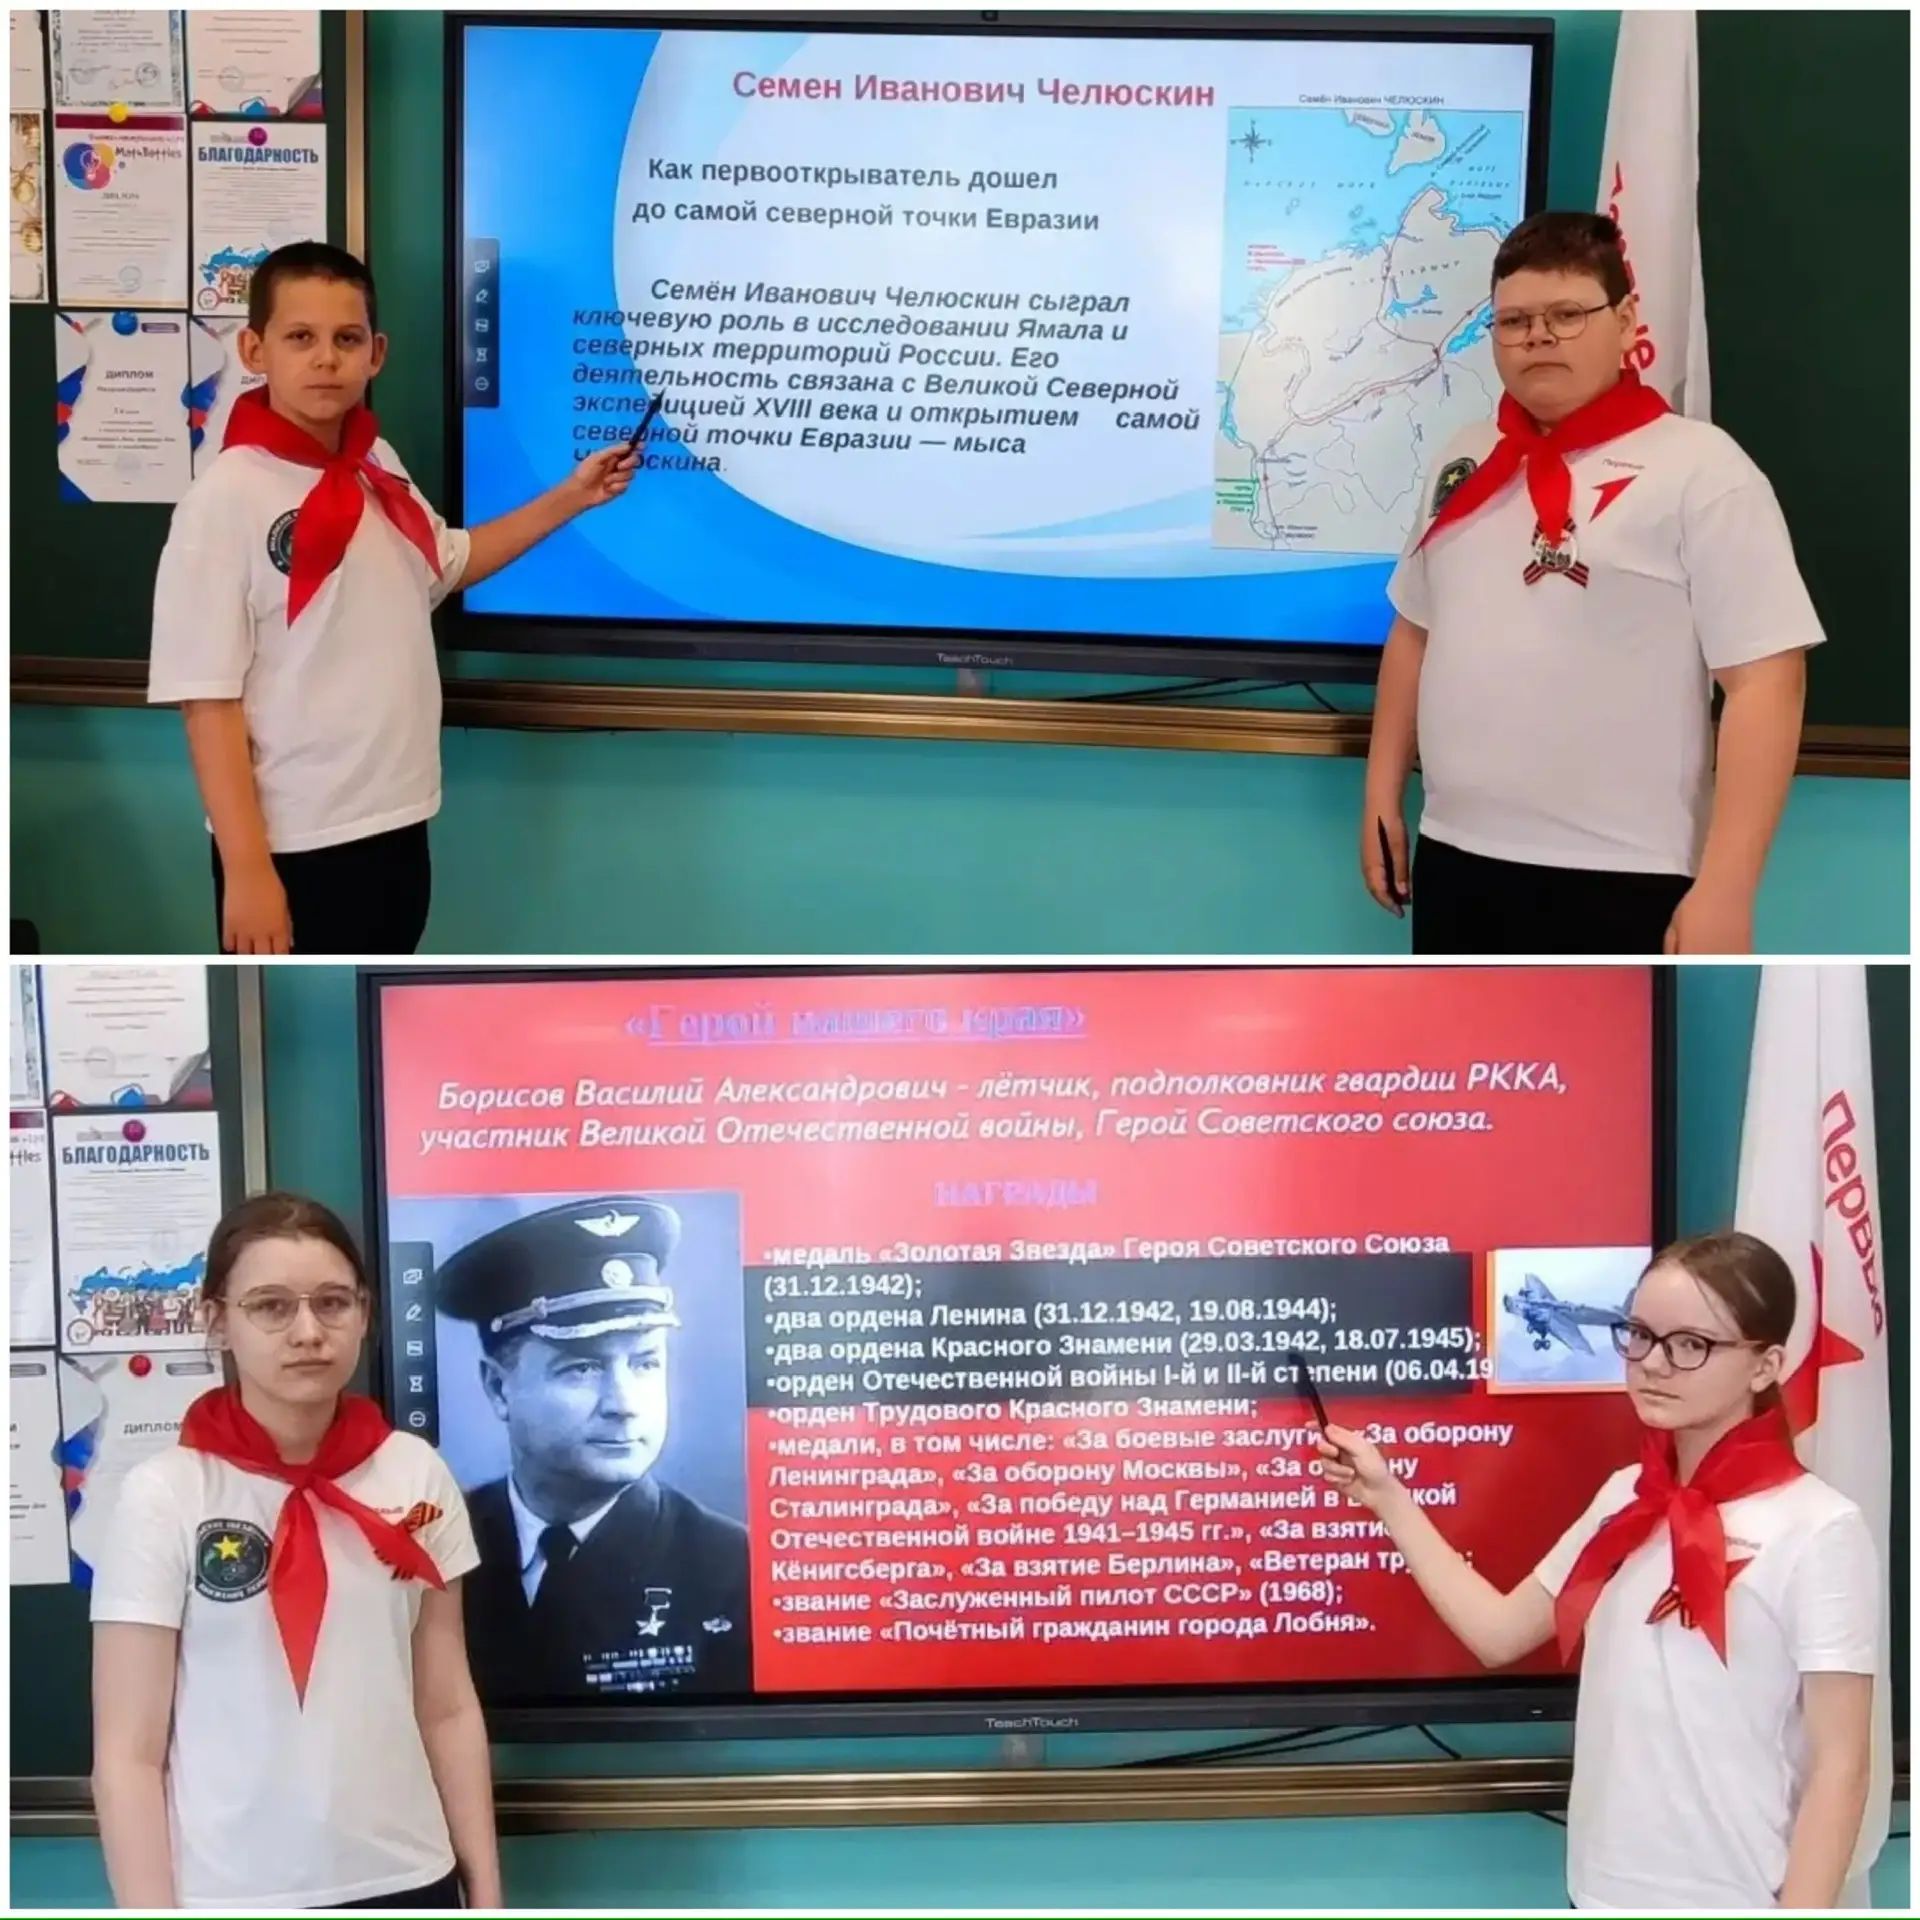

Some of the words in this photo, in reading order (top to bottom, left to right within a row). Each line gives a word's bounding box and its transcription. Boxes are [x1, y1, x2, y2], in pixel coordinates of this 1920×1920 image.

[733, 71, 841, 100] Семен
[854, 73, 1025, 104] Иванович
[1037, 78, 1215, 107] Челюскин
[198, 146, 319, 164] БЛАГОДАРНОСТЬ
[648, 158, 693, 180] Как
[701, 163, 961, 188] первооткрыватель
[968, 169, 1058, 192] дошел
[632, 201, 666, 223] до
[674, 201, 757, 223] самой
[766, 204, 893, 229] северной
[903, 209, 977, 228] точки
[986, 208, 1099, 232] Евразии
[651, 278, 736, 301] Семён
[745, 282, 876, 305] Иванович
[886, 286, 1019, 310] Челюскин
[1029, 293, 1129, 316] сыграл
[573, 309, 711, 333] ключевую
[719, 314, 784, 334] роль
[793, 316, 808, 332] в
[818, 314, 1008, 338] исследовании
[1017, 318, 1102, 340] Ямала
[1112, 324, 1128, 340] и
[573, 337, 704, 361] северных
[712, 340, 890, 366] территорий
[898, 344, 1002, 367] России.
[1010, 347, 1059, 368] Его
[573, 363, 778, 389] деятельность
[787, 373, 893, 392] связана
[902, 377, 915, 392] с
[924, 373, 1037, 396] Великой
[1046, 376, 1179, 403] Северной
[753, 397, 812, 418] XVIII
[819, 402, 877, 421] века
[887, 405, 902, 421] и
[910, 404, 1079, 428] открытием
[1116, 408, 1200, 430] самой
[706, 427, 792, 447] точки
[800, 427, 911, 452] Евразии
[953, 435, 1026, 454] мыса
[438, 1082, 564, 1114] Борисов
[575, 1078, 704, 1109] Василий
[714, 1075, 947, 1108] Александрович
[975, 1071, 1100, 1102] лётчик,
[1110, 1069, 1325, 1097] подполковник
[1332, 1067, 1456, 1099] гвардии
[1466, 1061, 1568, 1094] РККА,
[420, 1126, 569, 1155] участник
[578, 1118, 706, 1149] Великой
[715, 1113, 970, 1146] Отечественной
[978, 1112, 1085, 1143] войны,
[1095, 1107, 1189, 1142] Герой
[1197, 1107, 1385, 1135] Советского
[1392, 1110, 1495, 1133] союза.
[62, 1143, 210, 1165] БЛАГОДАРНОСТЬ
[879, 1242, 1000, 1264] «Золотая
[1009, 1240, 1115, 1266] Звезда»
[1123, 1238, 1200, 1263] Героя
[1207, 1236, 1357, 1257] Советского
[1364, 1234, 1449, 1254] Союза
[763, 1273, 923, 1302] (31.12.1942);
[828, 1308, 923, 1332] ордена
[930, 1304, 1026, 1327] Ленина
[1034, 1301, 1182, 1330] (31.12.1942,
[1190, 1297, 1337, 1323] 19.08.1944);
[829, 1340, 925, 1364] ордена
[931, 1336, 1051, 1360] Красного
[1058, 1333, 1172, 1355] Знамени
[1180, 1330, 1327, 1358] (29.03.1942,
[1334, 1326, 1481, 1352] 18.07.1945);
[862, 1365, 1063, 1391] Отечественной
[1071, 1364, 1155, 1387] войны
[1204, 1368, 1218, 1385] и
[862, 1401, 1001, 1425] Трудового
[1009, 1398, 1128, 1421] Красного
[1137, 1397, 1257, 1419] Знамени;
[890, 1437, 905, 1453] в
[913, 1435, 961, 1453] том
[969, 1432, 1054, 1452] числе:
[1063, 1429, 1107, 1449] «За
[1115, 1427, 1215, 1447] боевые
[1404, 1421, 1513, 1446] оборону
[769, 1465, 943, 1489] Ленинграда»,
[952, 1462, 997, 1483] «За
[1005, 1461, 1115, 1487] оборону
[1122, 1457, 1248, 1481] Москвы»,
[1255, 1457, 1301, 1478] «За
[769, 1494, 959, 1520] Сталинграда»,
[967, 1492, 1012, 1514] «За
[1020, 1492, 1112, 1518] победу
[1121, 1491, 1168, 1514] над
[1174, 1487, 1316, 1513] Германией
[1323, 1489, 1338, 1506] в
[770, 1524, 969, 1550] Отечественной
[977, 1523, 1055, 1546] войне
[1201, 1521, 1252, 1545] гг.»,
[1259, 1518, 1303, 1539] «За
[771, 1559, 953, 1584] Кёнигсберга»,
[961, 1556, 1006, 1578] «За
[1013, 1557, 1100, 1576] взятие
[1108, 1553, 1242, 1577] Берлина»,
[1249, 1549, 1369, 1573] «Ветеран
[880, 1586, 1072, 1613] «Заслуженный
[1080, 1586, 1156, 1605] пилот
[1163, 1582, 1252, 1604] СССР»
[1259, 1579, 1343, 1607] (1968);
[880, 1617, 1025, 1641] «Почётный
[1032, 1614, 1170, 1642] гражданин
[1178, 1612, 1267, 1638] города
[1274, 1610, 1376, 1634] Лобня».
